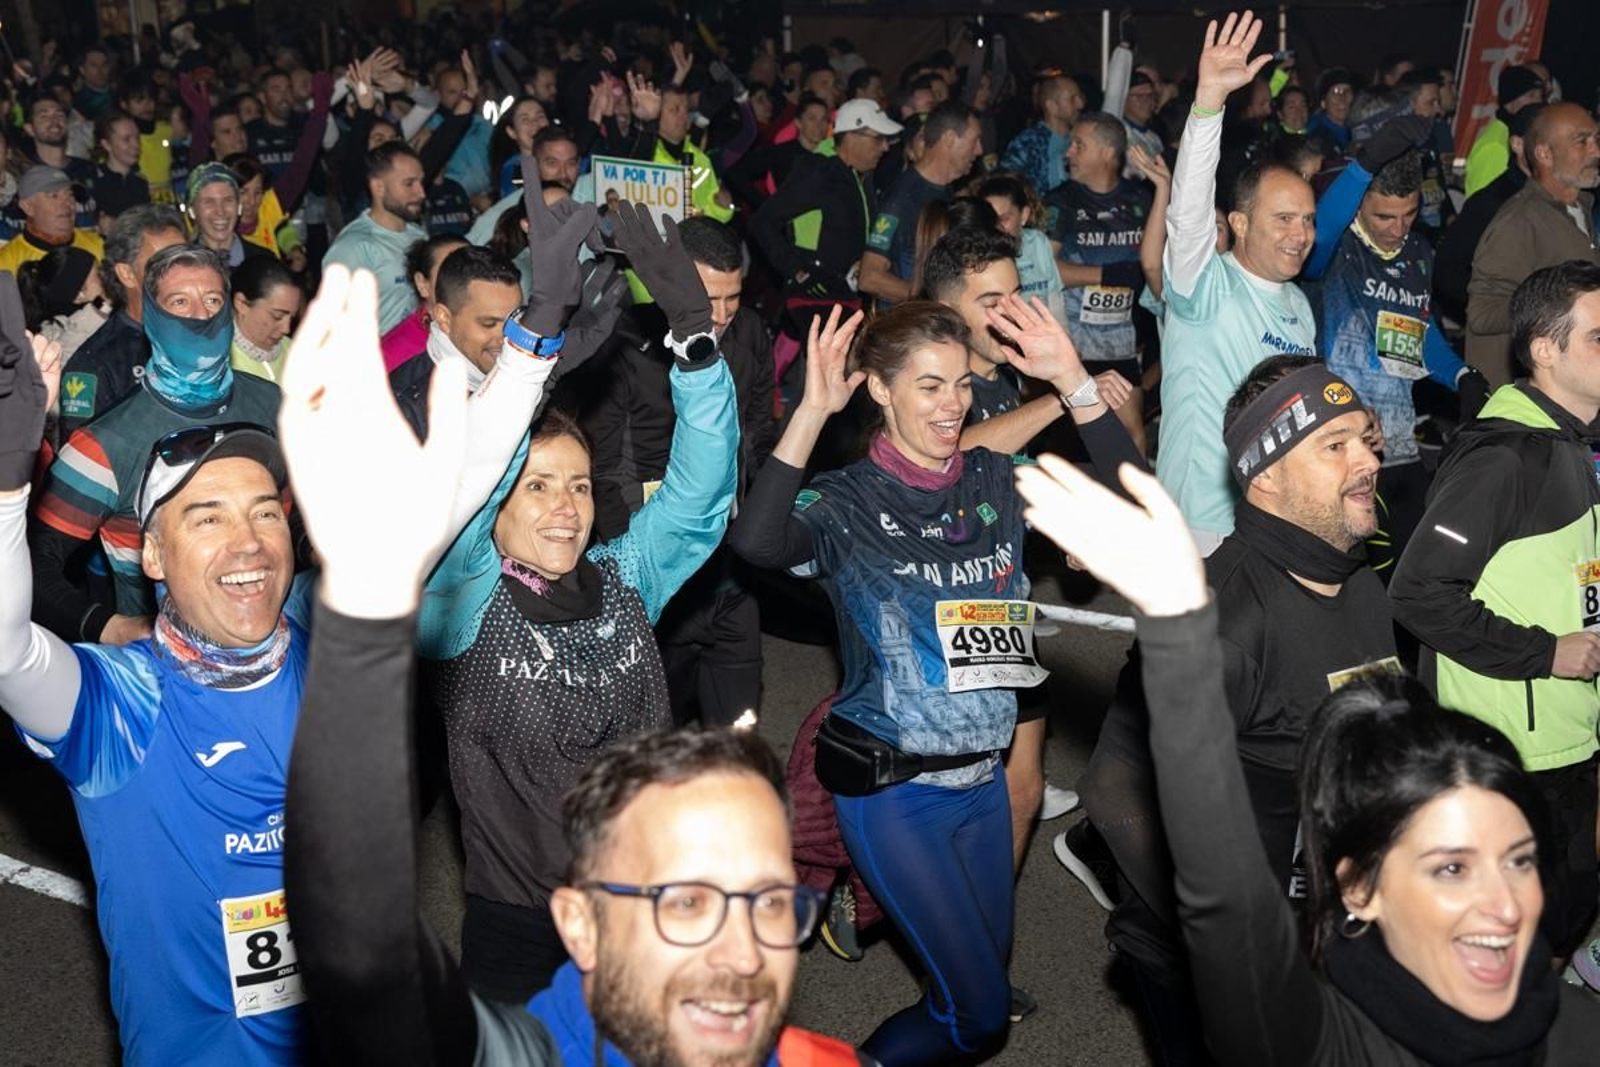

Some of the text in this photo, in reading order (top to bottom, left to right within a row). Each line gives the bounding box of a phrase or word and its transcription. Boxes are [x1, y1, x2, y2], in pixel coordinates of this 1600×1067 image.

[603, 164, 667, 186] VA POR TI
[1077, 231, 1105, 246] SAN
[1363, 278, 1398, 302] SAN
[951, 626, 1027, 655] 4980
[246, 930, 292, 970] 8
